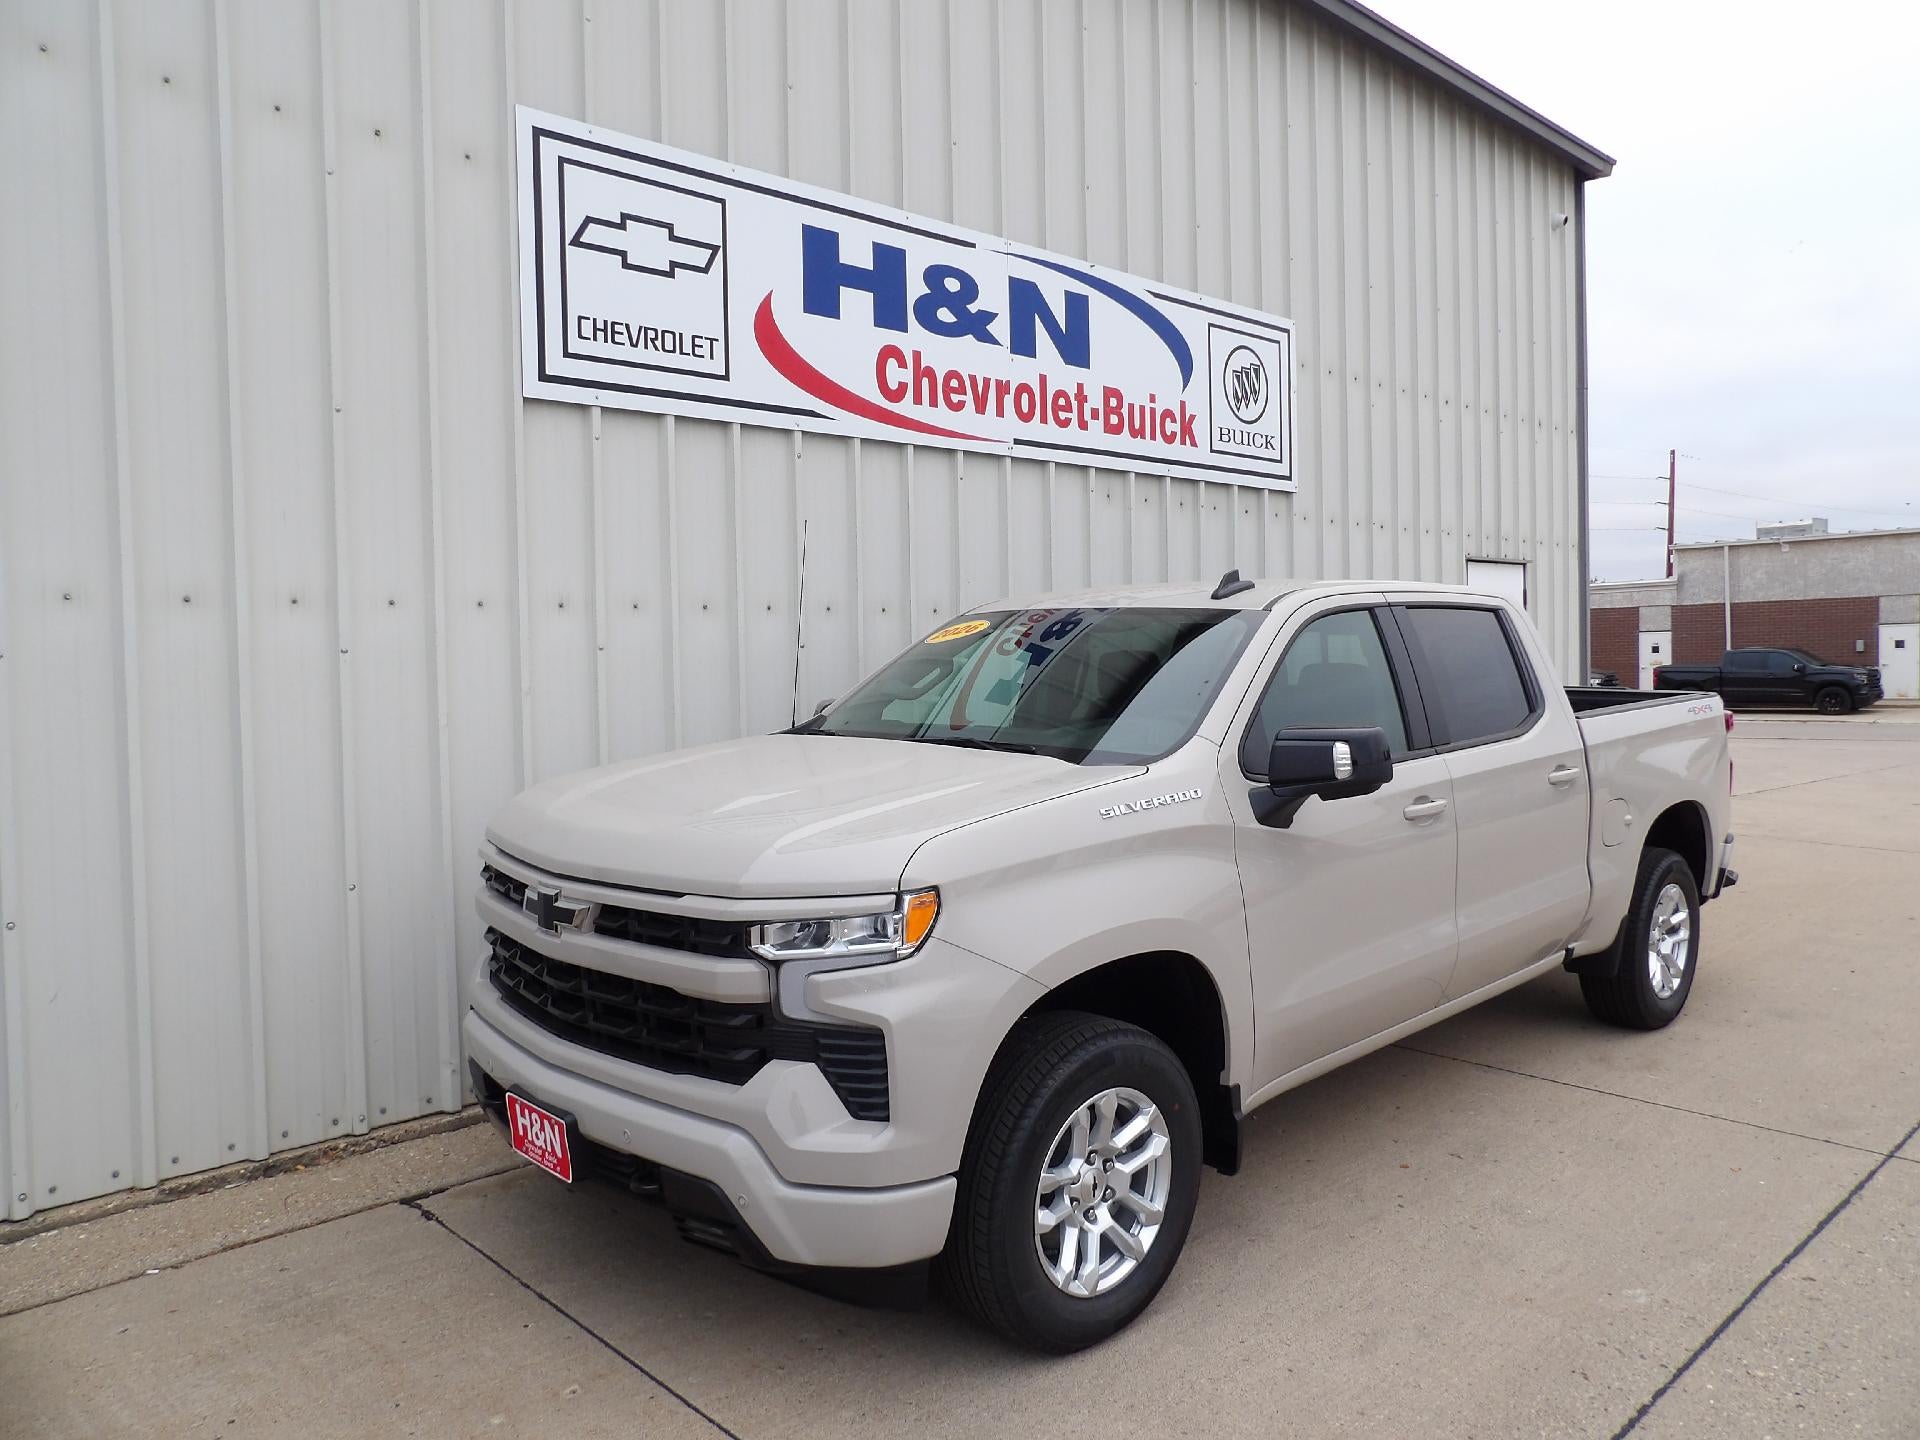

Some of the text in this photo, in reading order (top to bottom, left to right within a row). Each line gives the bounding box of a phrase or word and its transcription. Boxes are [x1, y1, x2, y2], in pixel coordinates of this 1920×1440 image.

[801, 223, 1090, 369] H&N
[577, 315, 719, 361] CHEVROLET
[875, 343, 1199, 448] Chevrolet-Buick
[1218, 426, 1276, 451] BUICK
[1099, 788, 1202, 819] SILVERADO
[515, 1103, 563, 1158] H&N
